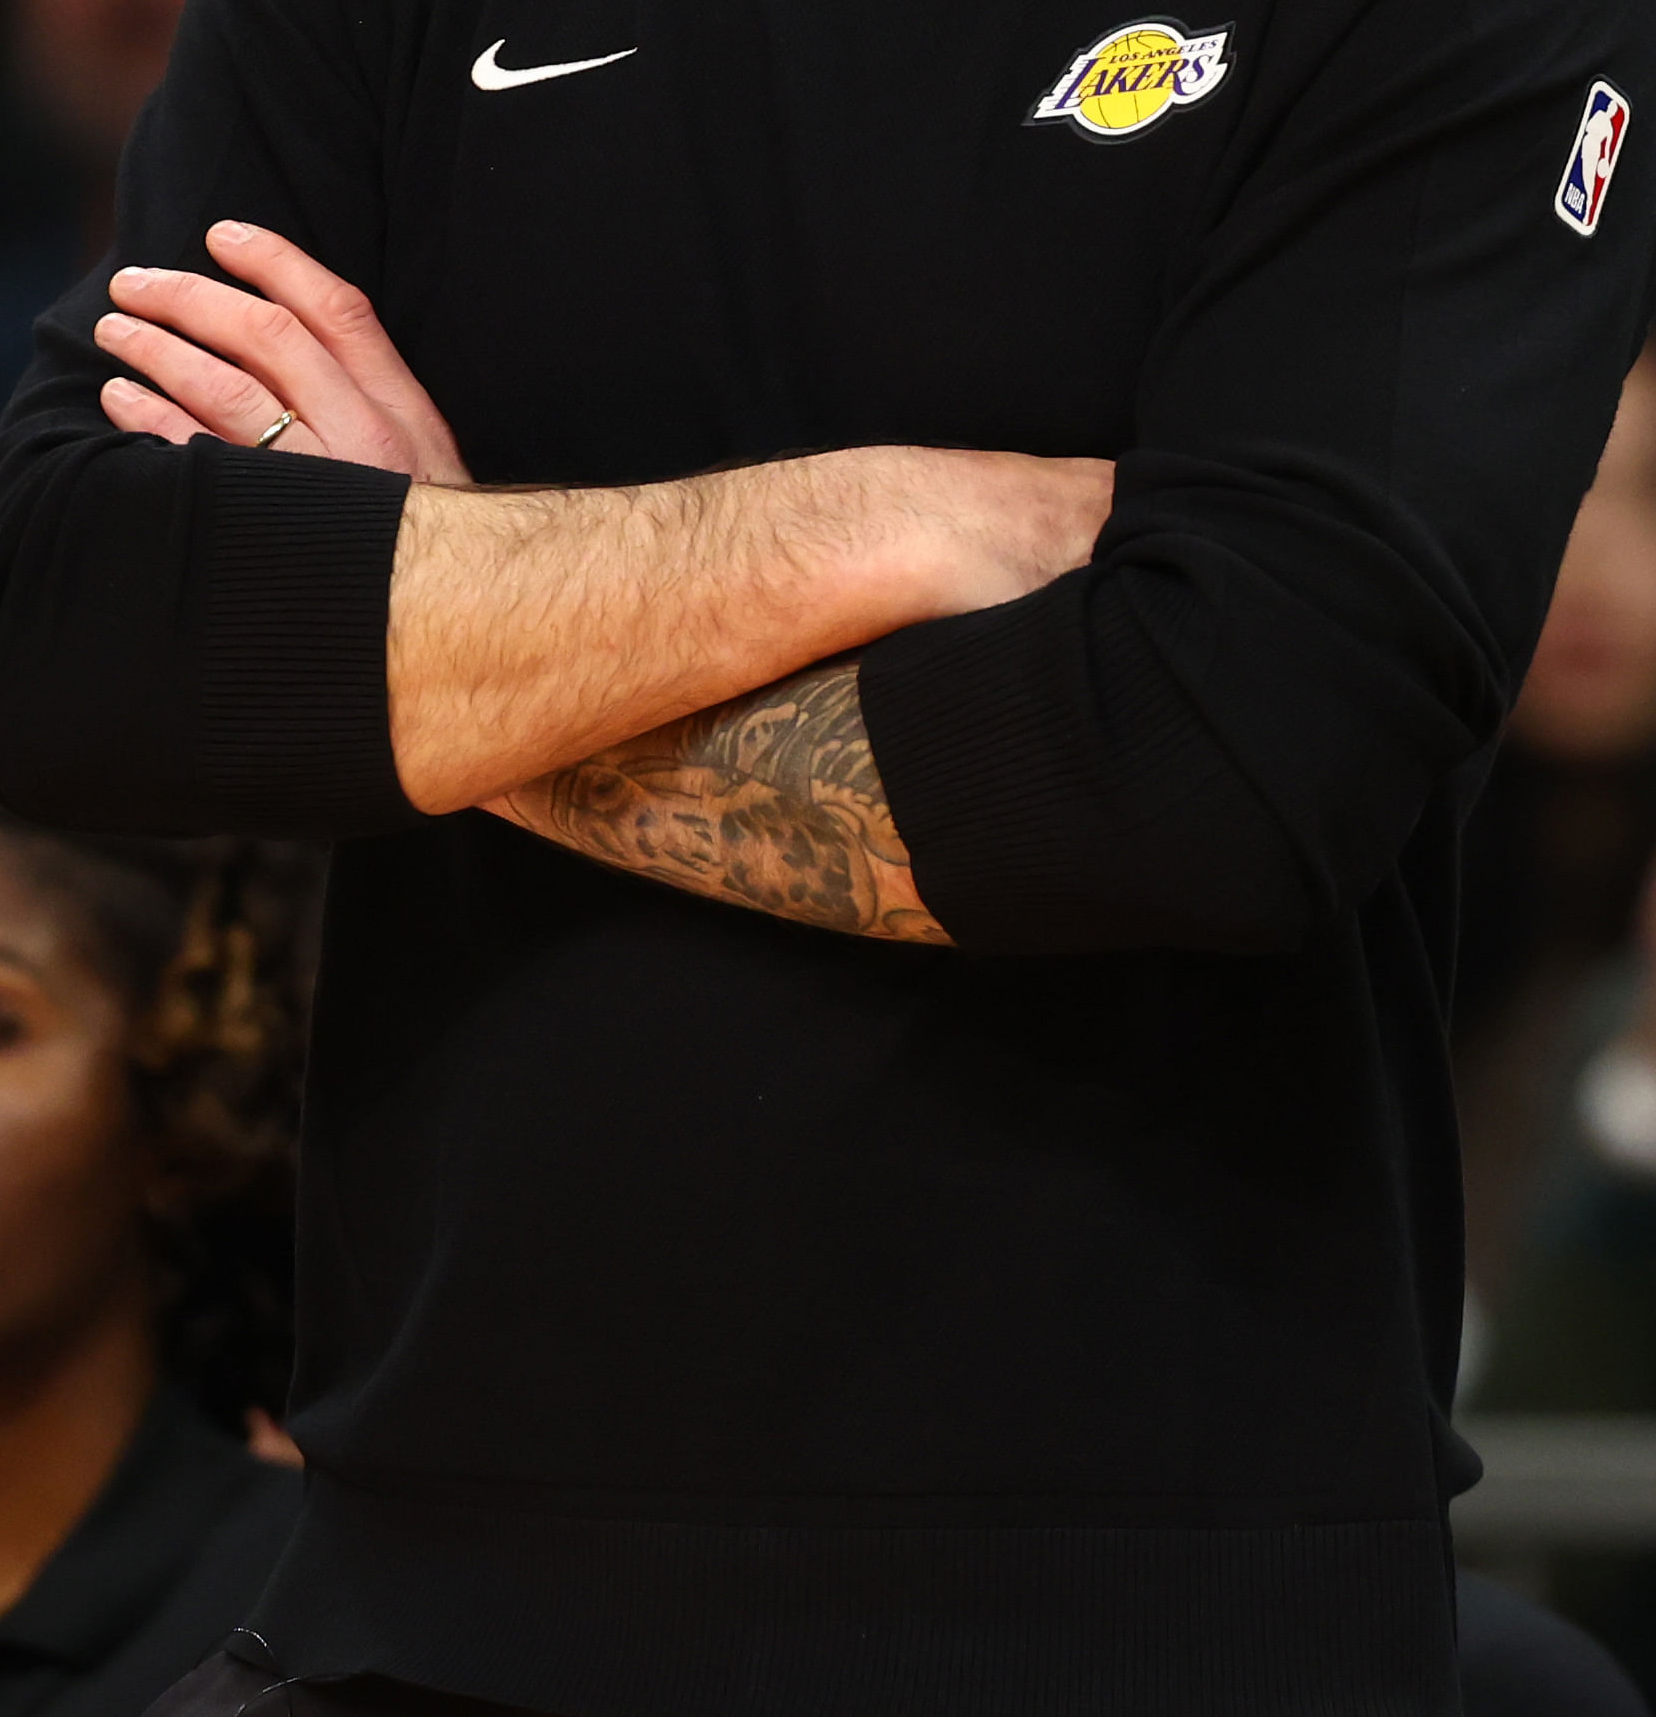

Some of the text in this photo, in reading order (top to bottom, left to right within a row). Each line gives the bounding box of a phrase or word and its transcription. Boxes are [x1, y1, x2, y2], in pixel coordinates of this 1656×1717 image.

[1109, 39, 1219, 64] LOS ANGELES
[1051, 54, 1214, 110] LAKERS
[1564, 182, 1585, 214] NBA
